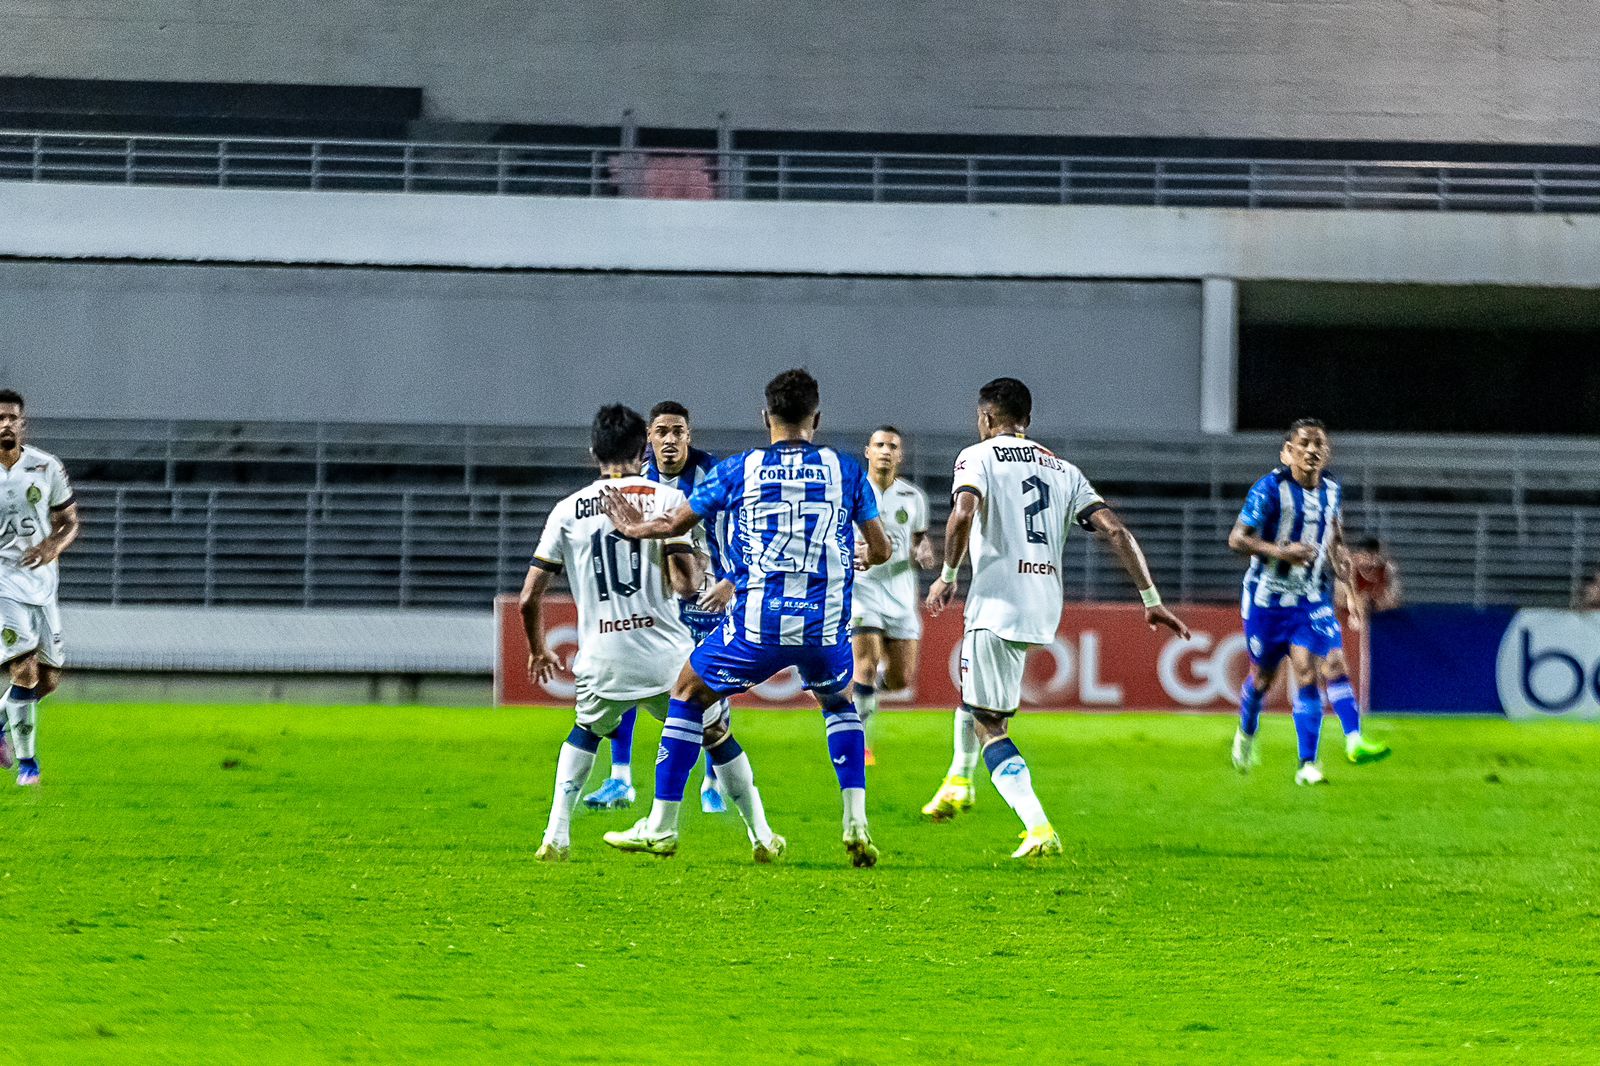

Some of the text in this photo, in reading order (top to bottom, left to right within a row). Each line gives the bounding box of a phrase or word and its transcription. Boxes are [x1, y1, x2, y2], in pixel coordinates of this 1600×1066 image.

[759, 467, 827, 481] CORINGA
[1021, 474, 1051, 546] 2
[591, 527, 642, 602] 10
[753, 500, 834, 574] 27
[599, 613, 655, 634] Incefra
